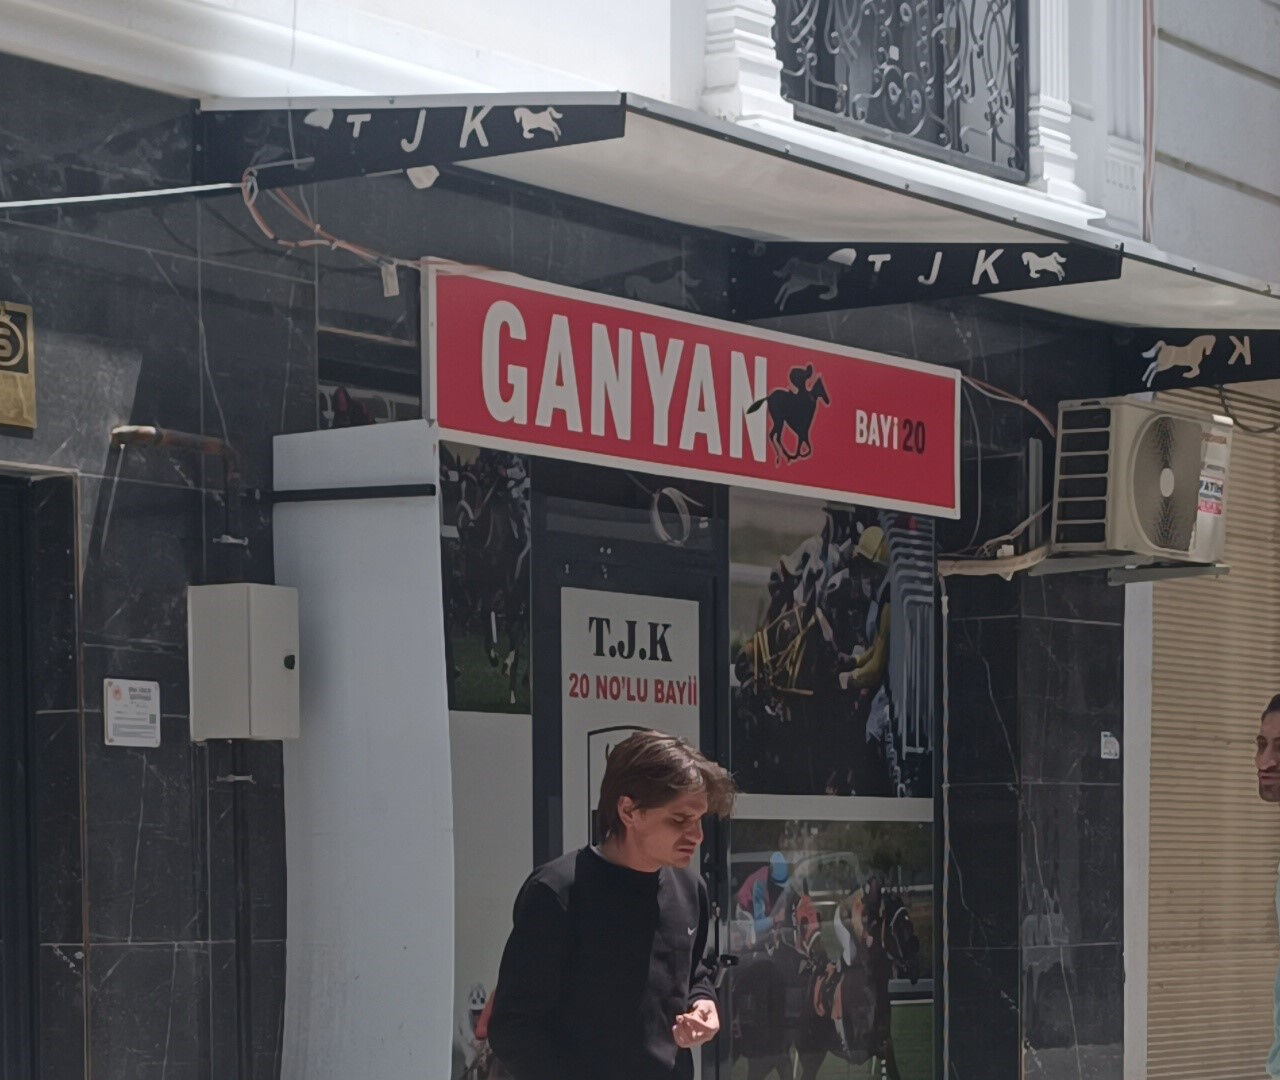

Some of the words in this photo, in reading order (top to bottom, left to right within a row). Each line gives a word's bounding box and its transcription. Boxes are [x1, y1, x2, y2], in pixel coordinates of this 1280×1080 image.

[481, 300, 768, 463] GANYAN
[902, 418, 926, 454] 20
[588, 616, 673, 662] T.J.K
[569, 673, 590, 699] 20
[596, 675, 648, 702] NO'LU
